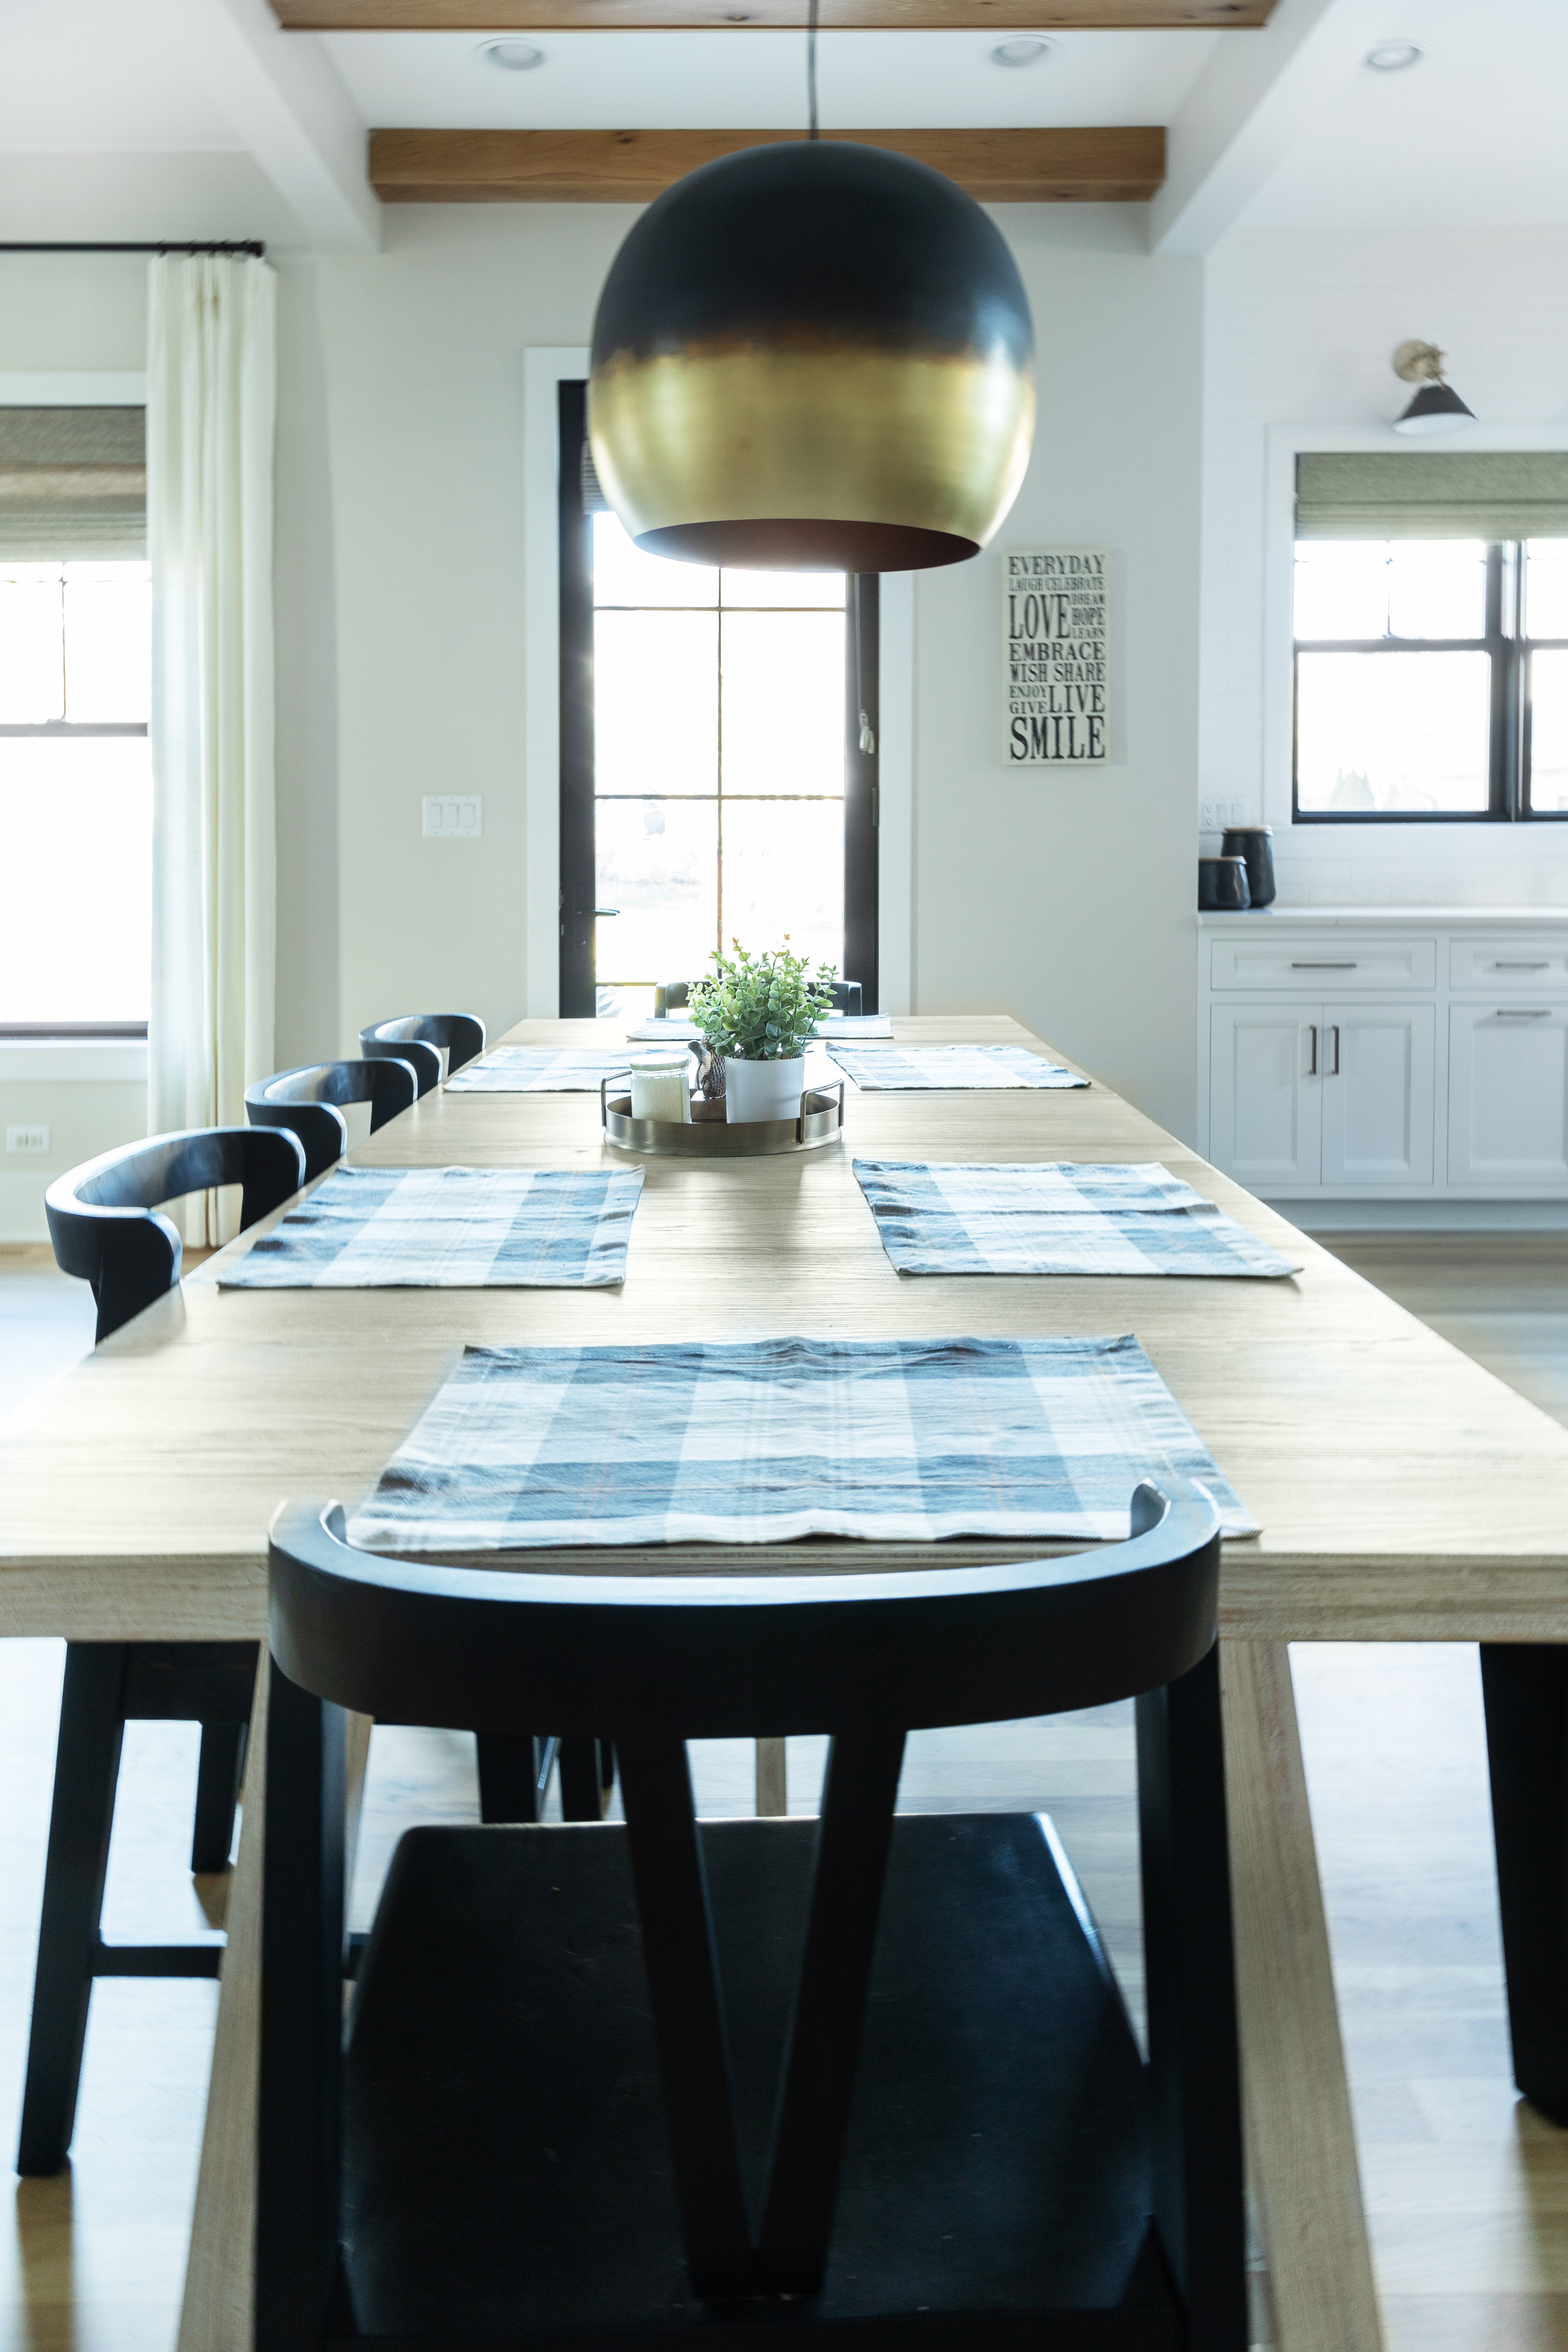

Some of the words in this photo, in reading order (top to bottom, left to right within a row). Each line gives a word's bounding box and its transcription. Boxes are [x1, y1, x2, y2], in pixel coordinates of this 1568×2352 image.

[1008, 554, 1105, 575] EVERYDAY
[1008, 594, 1070, 639] LOVE
[1008, 642, 1105, 661] EMBRACE
[1009, 663, 1047, 682] WISH
[1053, 662, 1105, 682] SHARE
[1009, 686, 1047, 698] ENJOY
[1049, 684, 1105, 713] LIVE
[1009, 701, 1047, 714] GIVE
[1010, 715, 1105, 760] SMILE
